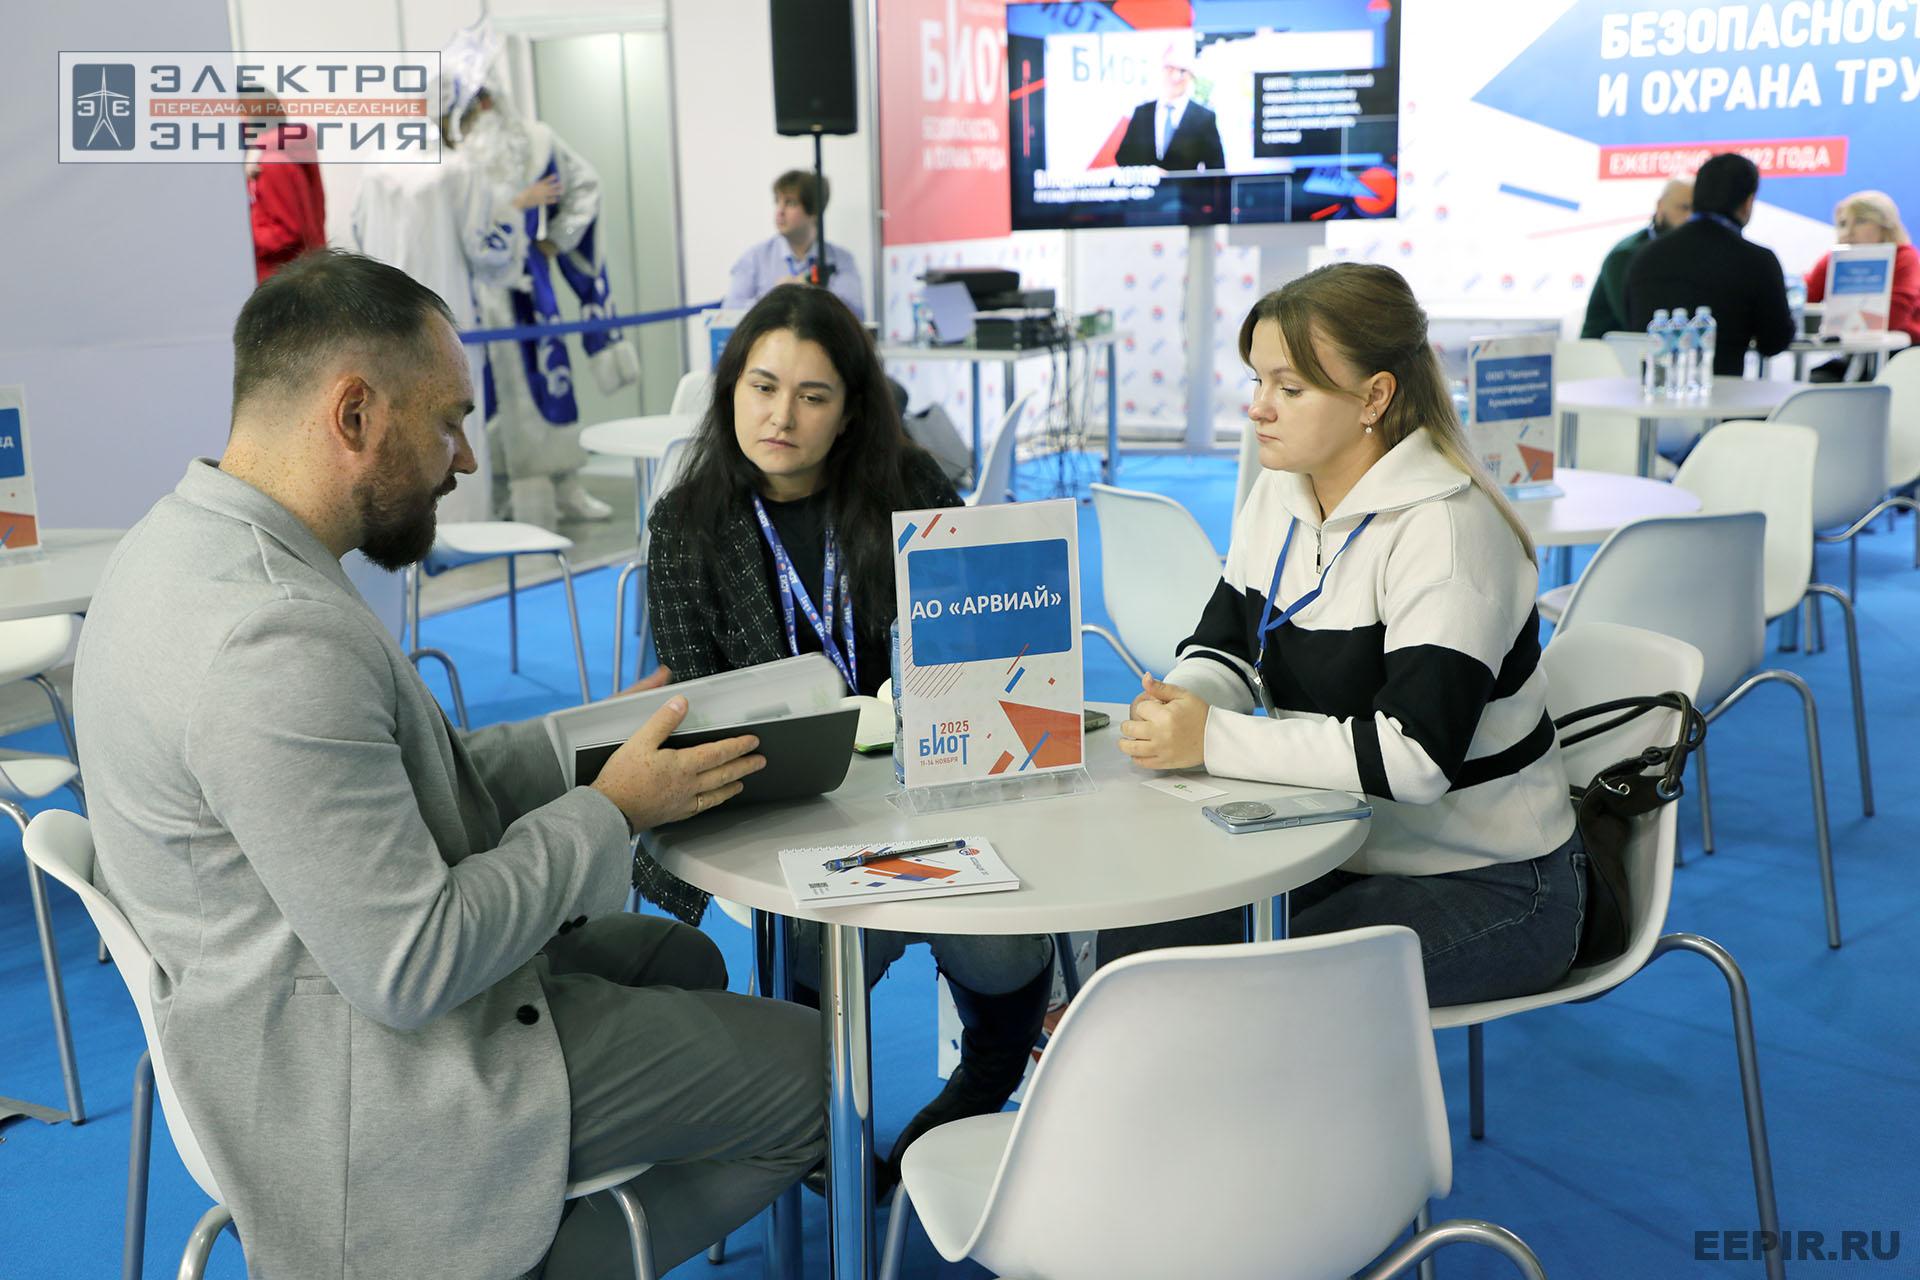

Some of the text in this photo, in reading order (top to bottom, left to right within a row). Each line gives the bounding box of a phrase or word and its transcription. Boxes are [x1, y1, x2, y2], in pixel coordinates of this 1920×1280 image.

[1597, 72, 1628, 117] И
[1641, 62, 1822, 116] ОХРАНА
[1776, 145, 1831, 171] ГОДА
[911, 584, 1062, 620] АО «АРВИАЙ»
[940, 720, 969, 735] 2025
[919, 723, 970, 766] БИОТ
[935, 756, 958, 766] НОЯБРЯ
